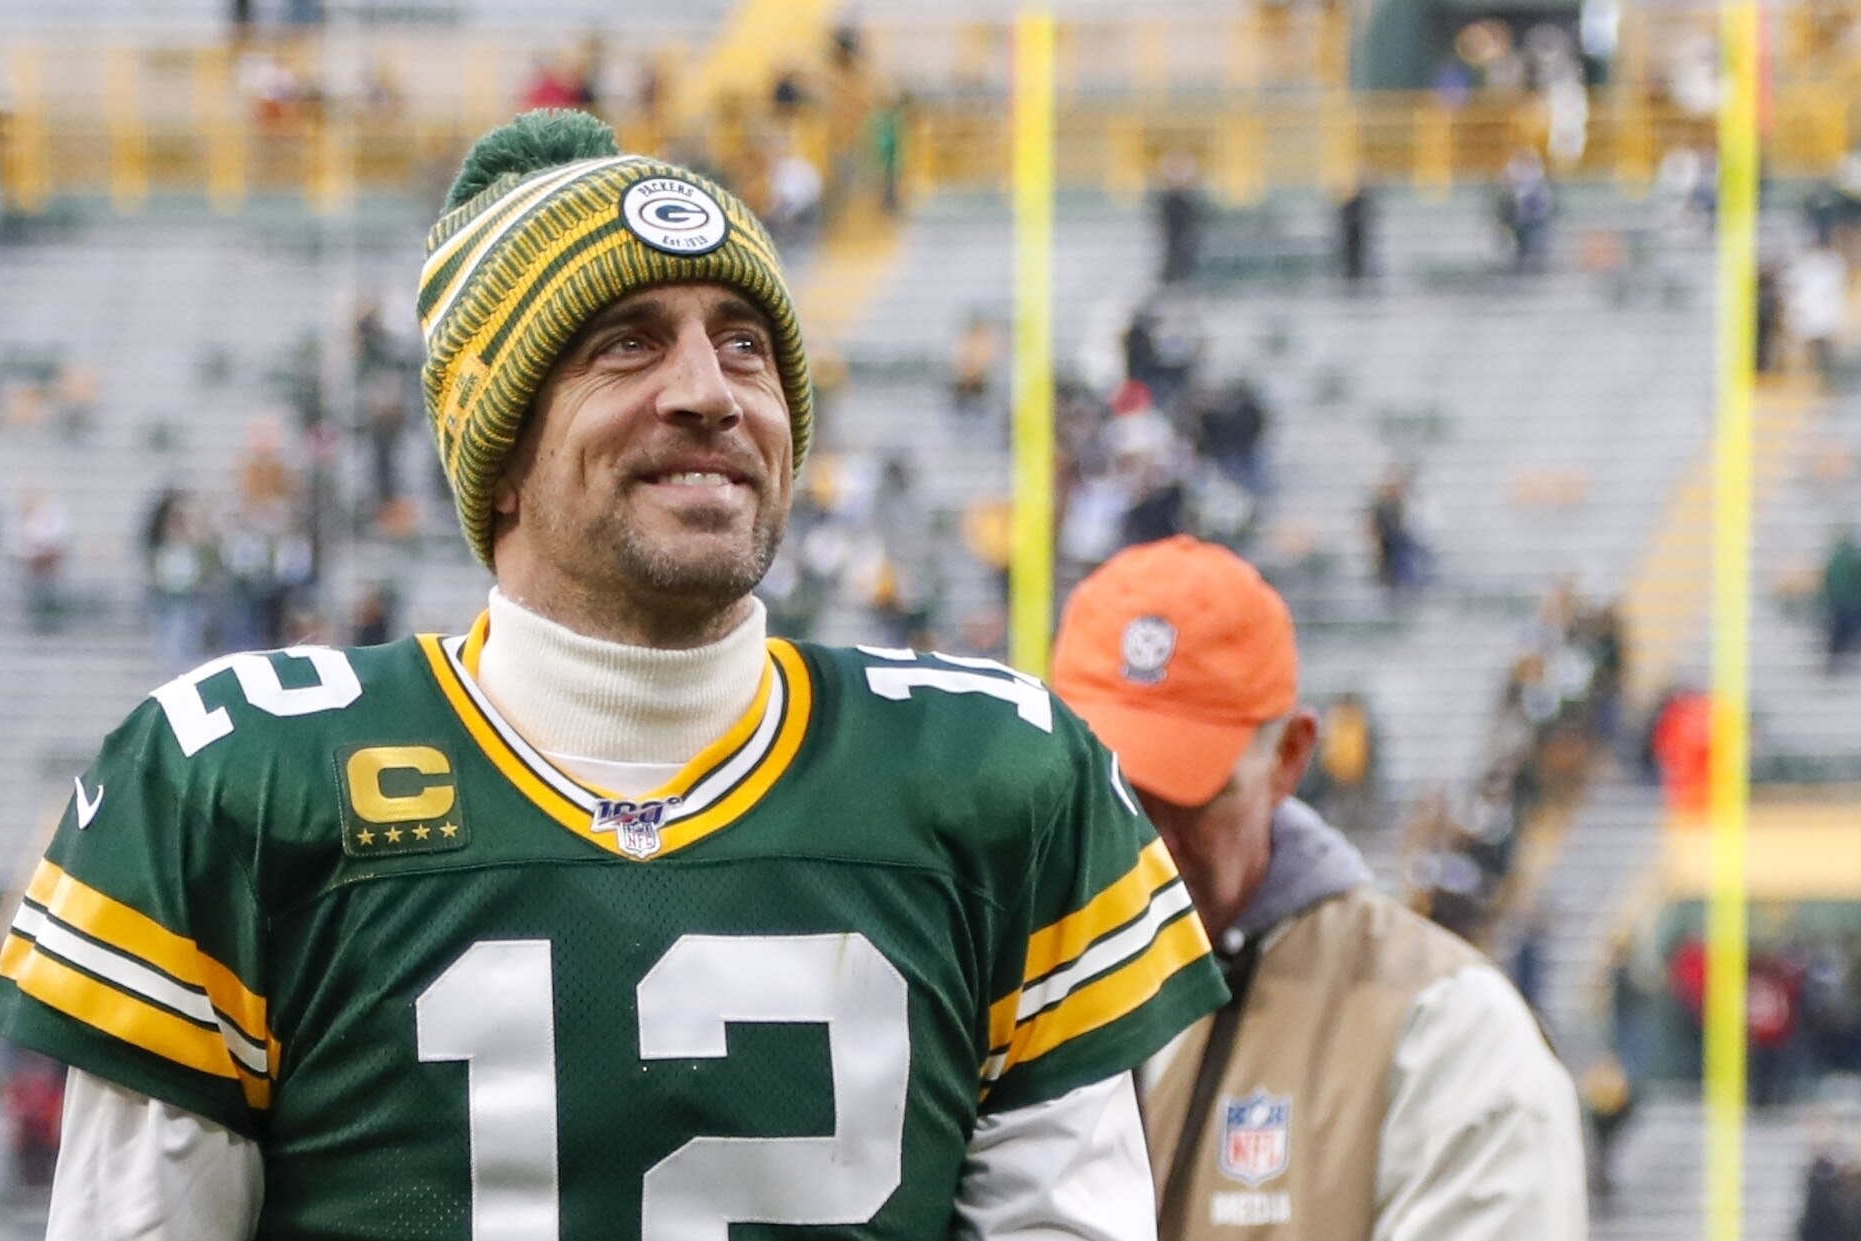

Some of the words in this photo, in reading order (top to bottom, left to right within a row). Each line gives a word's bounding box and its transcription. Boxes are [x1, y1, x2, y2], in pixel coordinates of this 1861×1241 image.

[637, 182, 694, 197] PACKERS
[640, 198, 709, 230] G
[346, 746, 455, 823] C
[628, 833, 653, 848] NFL
[1230, 1131, 1281, 1169] NFL
